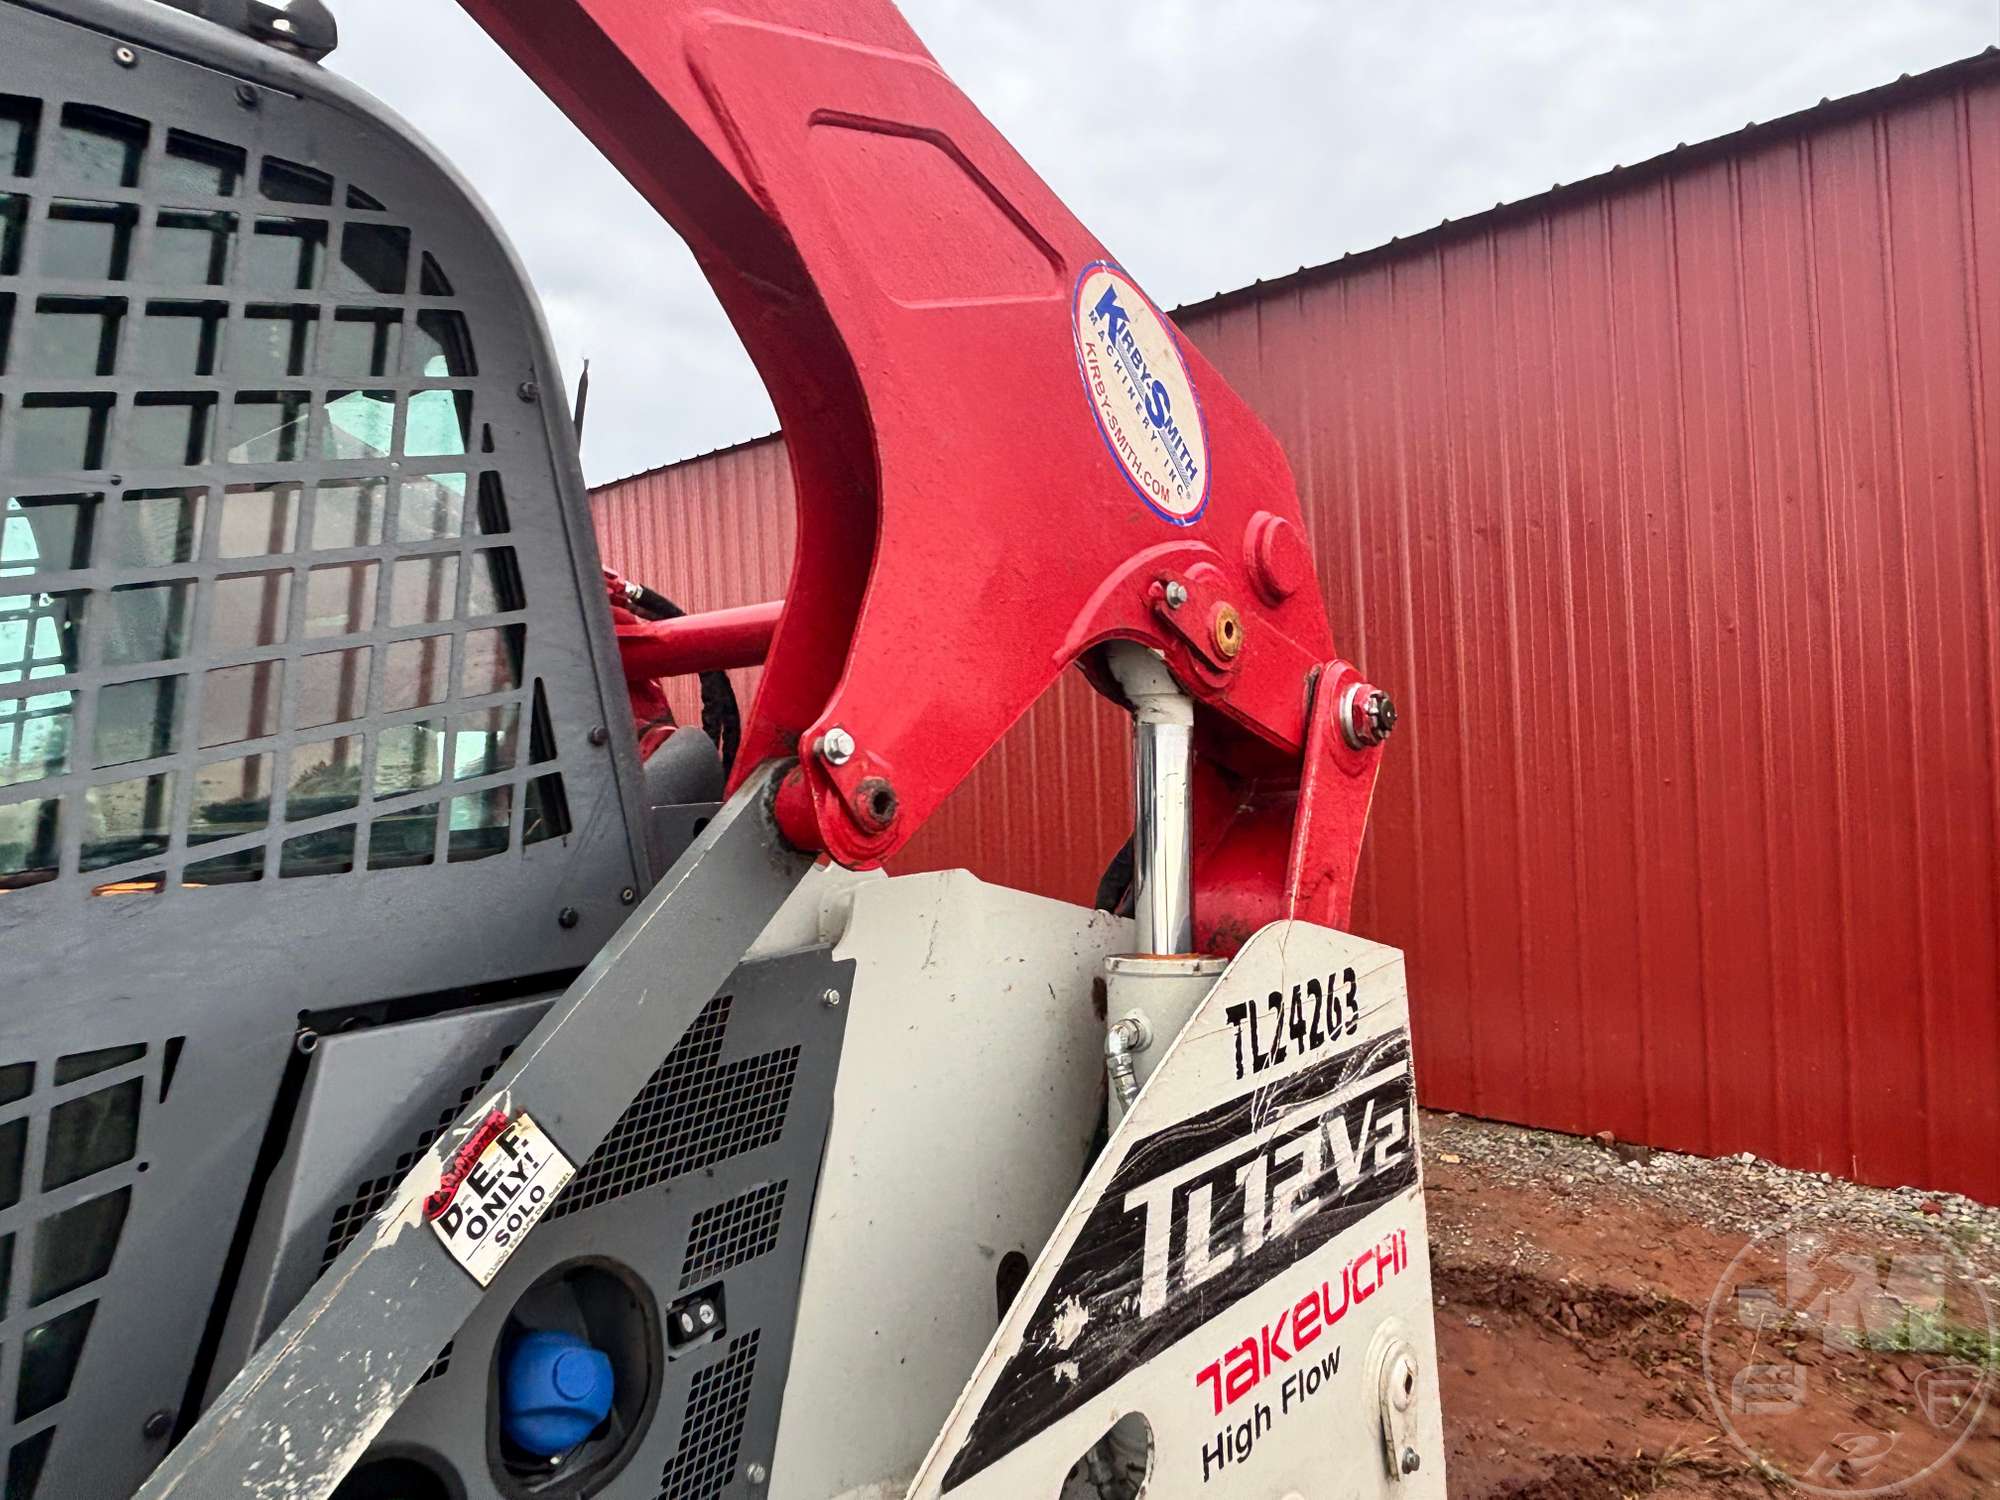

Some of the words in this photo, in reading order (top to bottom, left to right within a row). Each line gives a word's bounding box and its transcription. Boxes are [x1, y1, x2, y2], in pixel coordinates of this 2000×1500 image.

[1085, 341, 1170, 503] KIRBY-SMITH.COM
[1225, 967, 1360, 1080] TL24263
[466, 1152, 540, 1240] ONLY!
[1123, 1099, 1405, 1318] TL12V2
[1202, 1402, 1271, 1482] High
[1281, 1345, 1341, 1415] Flow
